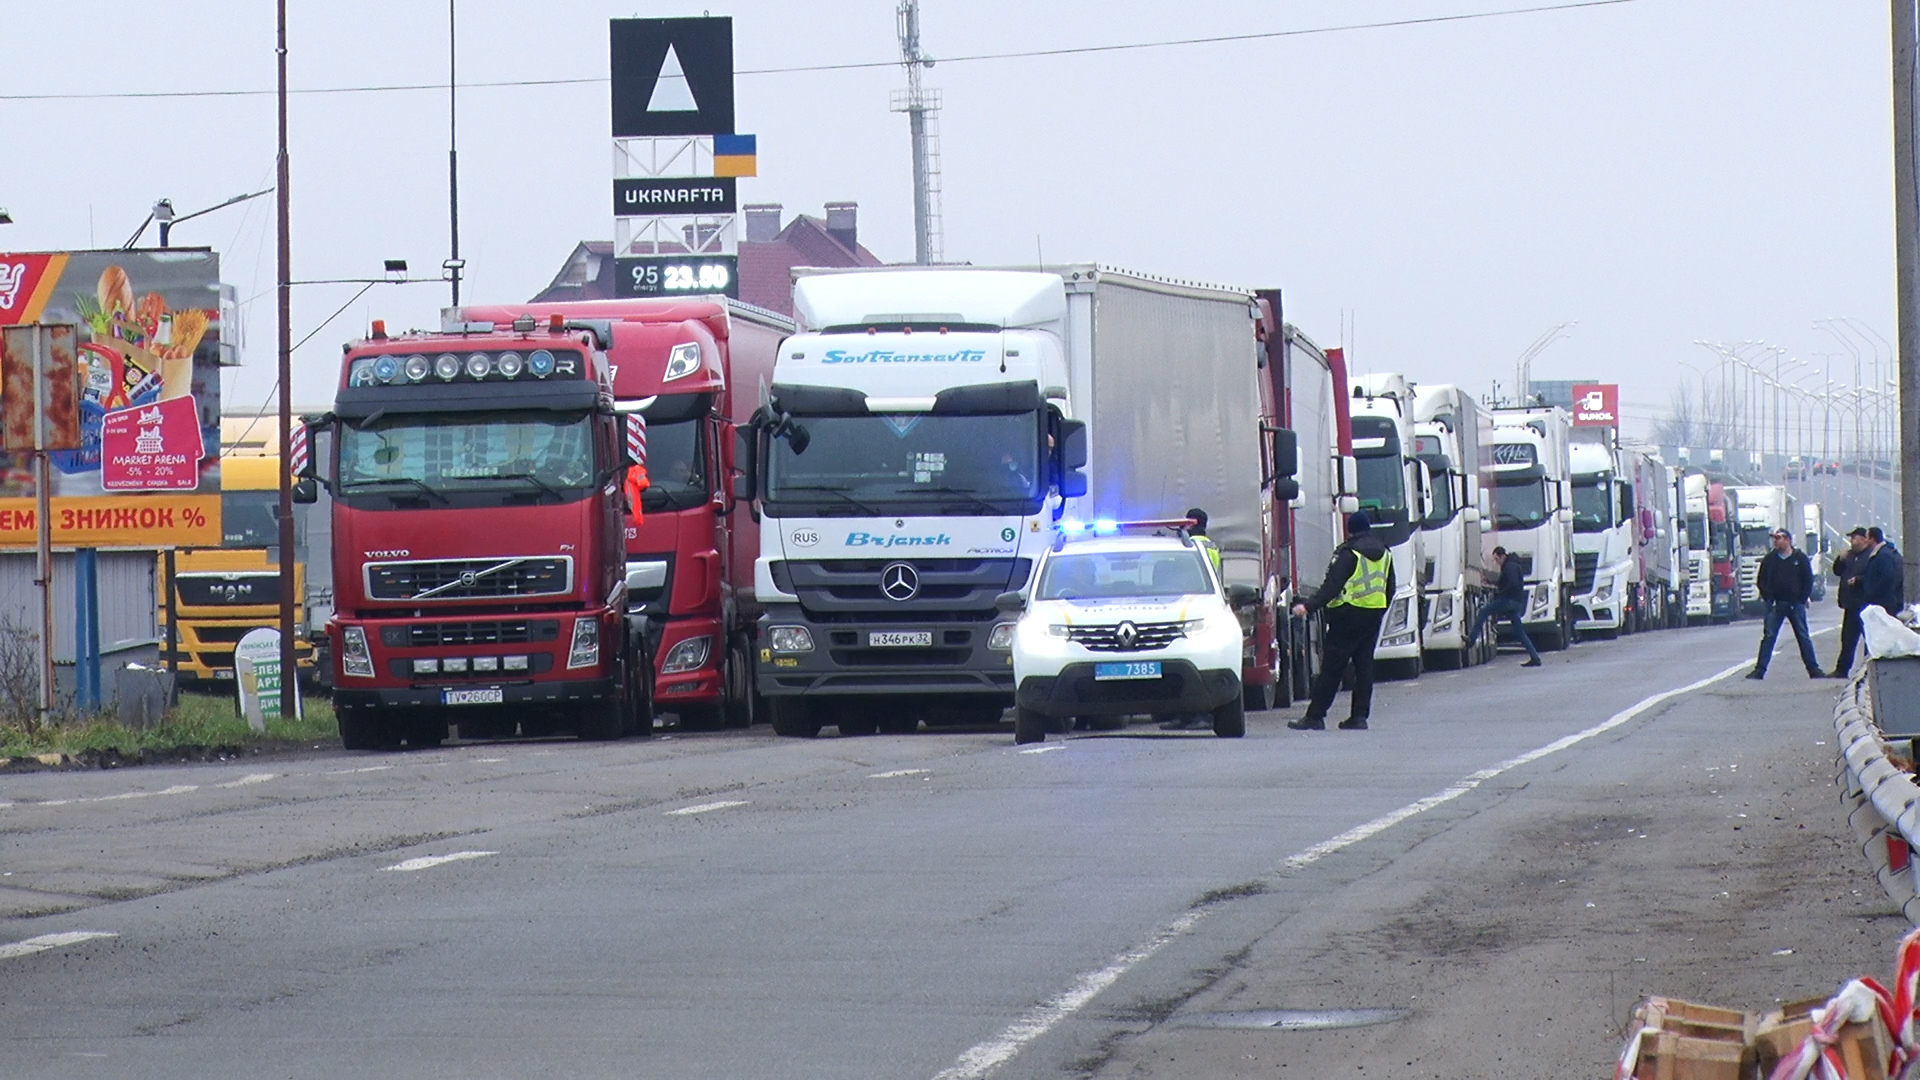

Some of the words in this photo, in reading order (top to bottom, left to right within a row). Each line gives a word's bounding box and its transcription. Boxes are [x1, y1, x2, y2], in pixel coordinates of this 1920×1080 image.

[625, 188, 724, 203] UKRNAFTA
[632, 266, 658, 284] 95
[633, 284, 658, 292] energy
[112, 455, 152, 466] MARKET
[154, 454, 187, 465] ARENA
[154, 466, 174, 476] 20%
[0, 511, 50, 530] ЕМ
[60, 508, 174, 529] ЗНИЖОК
[182, 507, 205, 528] %
[793, 533, 818, 543] RUS
[844, 532, 952, 548] Brjansk
[364, 549, 410, 558] VOLVO
[210, 584, 252, 595] MAN
[918, 633, 928, 642] 32
[1125, 663, 1155, 676] 7385
